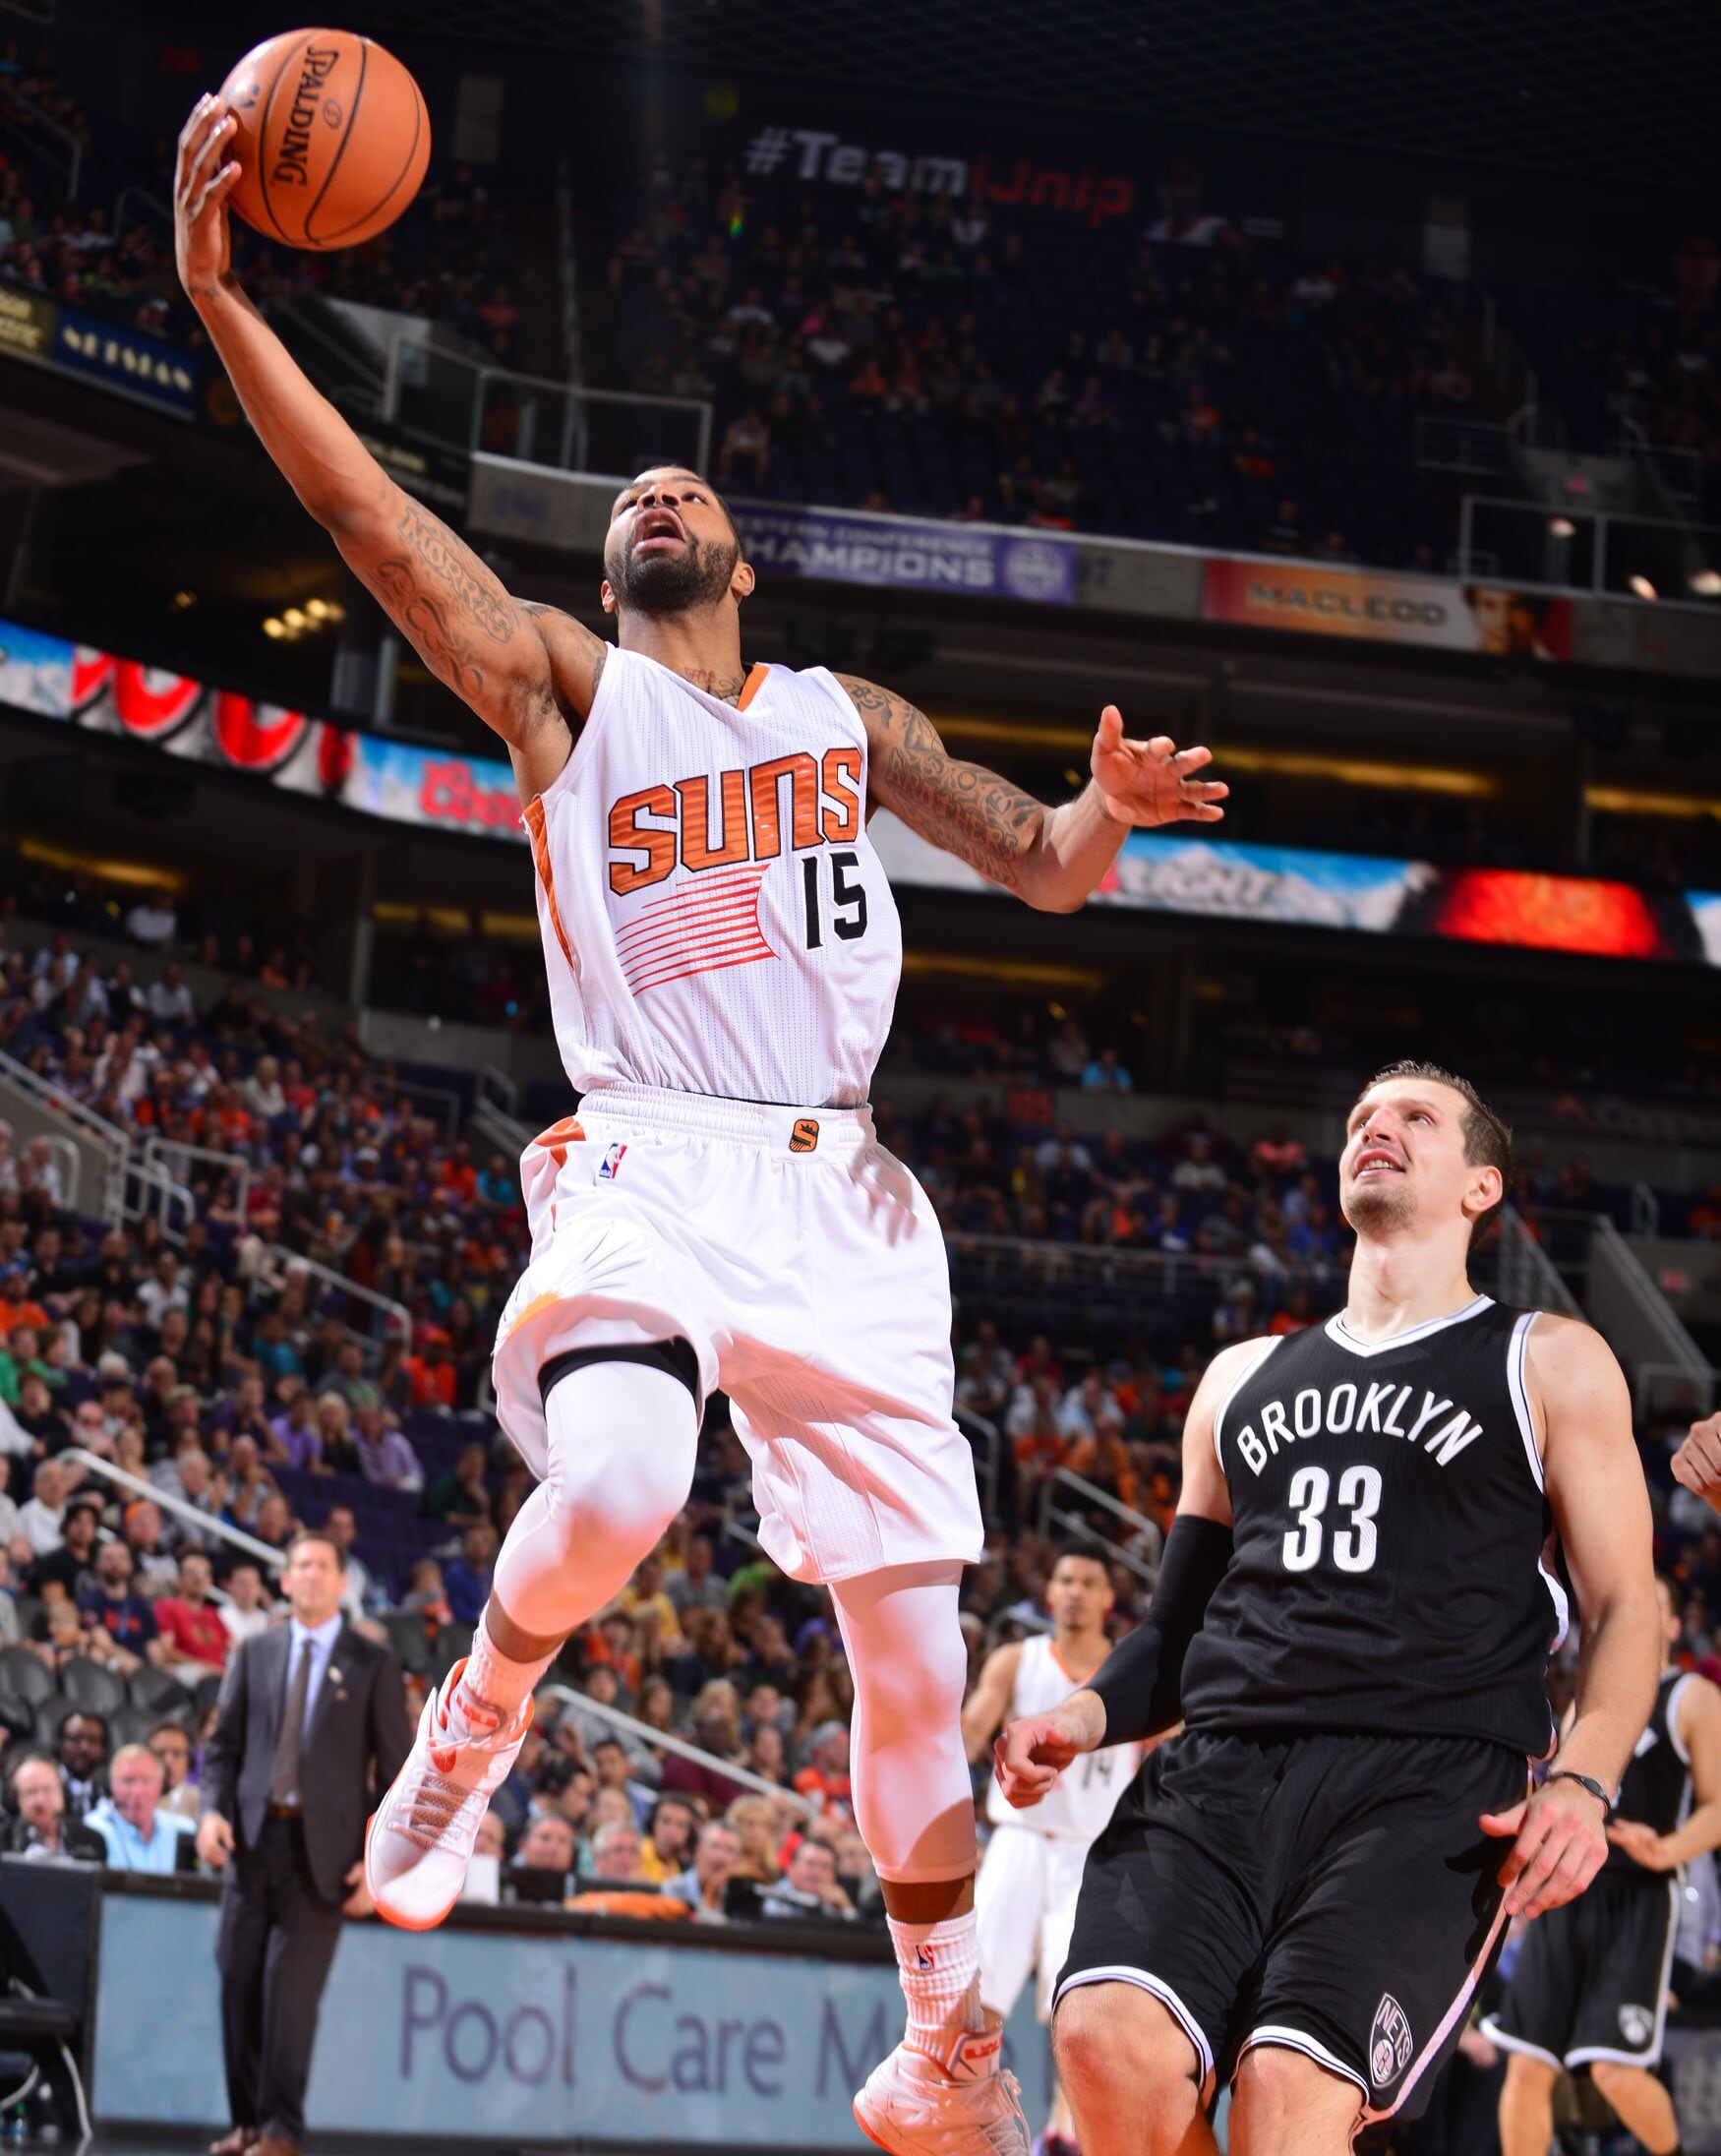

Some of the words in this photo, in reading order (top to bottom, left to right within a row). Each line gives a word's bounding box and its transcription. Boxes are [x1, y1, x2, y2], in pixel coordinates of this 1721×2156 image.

[272, 46, 339, 187] SPALDING
[744, 536, 995, 588] HAMPIONS
[1247, 581, 1449, 627] MACLEOD
[608, 748, 862, 897] SUNS
[801, 851, 868, 951] 15
[1236, 1382, 1484, 1477] BROOKLYN
[1281, 1465, 1383, 1573] 33
[399, 1962, 577, 2088] Pool
[613, 1981, 785, 2098] Care
[1377, 1999, 1410, 2068] NETS
